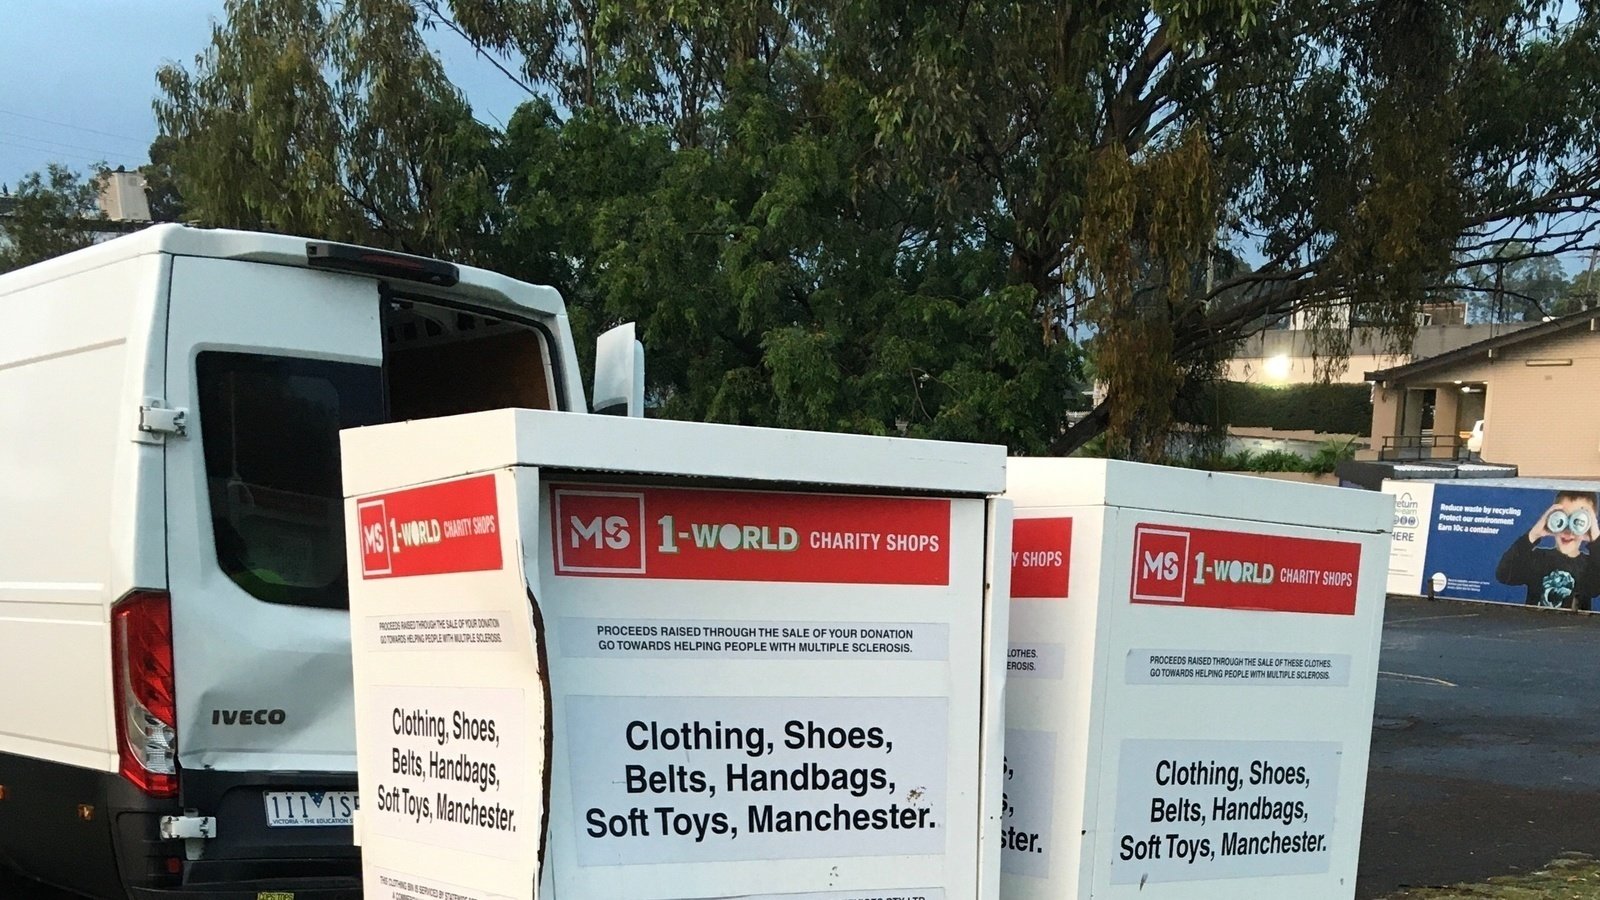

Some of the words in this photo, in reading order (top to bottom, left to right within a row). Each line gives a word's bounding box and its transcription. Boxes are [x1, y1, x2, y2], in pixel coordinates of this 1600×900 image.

[1439, 514, 1462, 522] Protect
[1474, 516, 1514, 525] environment
[1440, 504, 1463, 512] Reduce
[1483, 506, 1491, 514] by
[1492, 507, 1522, 516] recycling
[364, 524, 384, 554] MS
[390, 518, 441, 553] 1-WORLD
[444, 518, 472, 538] CHARITY
[474, 514, 496, 534] SHOPS
[570, 515, 630, 550] MS
[658, 515, 800, 554] 1-WORLD
[810, 532, 880, 550] CHARITY
[886, 534, 940, 552] SHOPS
[1438, 523, 1452, 531] Earn
[1453, 524, 1463, 532] 10c
[1470, 526, 1500, 534] container
[1022, 551, 1062, 567] SHOPS
[1143, 550, 1179, 581] MS
[1193, 552, 1274, 585] 1-WORLD
[1280, 568, 1320, 584] CHARITY
[1322, 570, 1352, 586] SHOPS
[379, 622, 400, 630] PROCEEDS
[597, 626, 658, 636] PROCEEDS
[660, 626, 700, 637] RAISED
[702, 627, 756, 637] THROUGH
[758, 628, 779, 638] THE
[782, 628, 810, 638] SALE
[812, 628, 827, 638] OF
[828, 629, 858, 639] YOUR
[860, 629, 913, 639] DONATION
[598, 640, 615, 650] GO
[616, 641, 671, 651] TOWARDS
[674, 641, 722, 651] HELPING
[724, 642, 767, 652] PEOPLE
[769, 642, 796, 652] WITH
[799, 643, 849, 652] MULTIPLE
[852, 643, 912, 653] SCLEROSIS.
[1150, 655, 1186, 665] PROCEEDS
[1188, 656, 1212, 666] RAISED
[1212, 656, 1244, 666] THROUGH
[1244, 657, 1256, 667] THE
[1257, 658, 1273, 667] SALE
[1274, 658, 1284, 667] OF
[1284, 658, 1303, 667] THESE
[1304, 659, 1332, 668] CLOTHES.
[1150, 668, 1160, 678] GO
[1161, 669, 1194, 678] TOWARDS
[1194, 669, 1223, 678] HELPING
[1224, 670, 1249, 679] PEOPLE
[1250, 670, 1265, 679] WITH
[1266, 670, 1295, 679] MULTIPLE
[1296, 671, 1330, 680] SCLEROSIS.
[212, 709, 286, 725] IVECO
[392, 708, 449, 745] Clothing,
[453, 710, 500, 748] Shoes,
[626, 720, 774, 757] Clothing,
[784, 720, 893, 754] Shoes,
[392, 748, 426, 782] Belts,
[430, 751, 500, 792] Handbags,
[625, 764, 716, 798] Belts,
[726, 762, 896, 797] Handbags,
[1156, 760, 1244, 791] Clothing,
[1249, 760, 1310, 788] Shoes,
[378, 784, 400, 812] Soft
[402, 788, 433, 824] Toys,
[437, 792, 516, 832] Manchester.
[586, 807, 649, 838] Soft
[654, 807, 738, 842] Toys,
[748, 804, 936, 833] Manchester.
[1150, 798, 1206, 826] Belts,
[1212, 796, 1308, 825] Handbags,
[1120, 834, 1161, 860] Soft
[1166, 834, 1215, 864] Toys,
[1221, 831, 1326, 856] Manchester.
